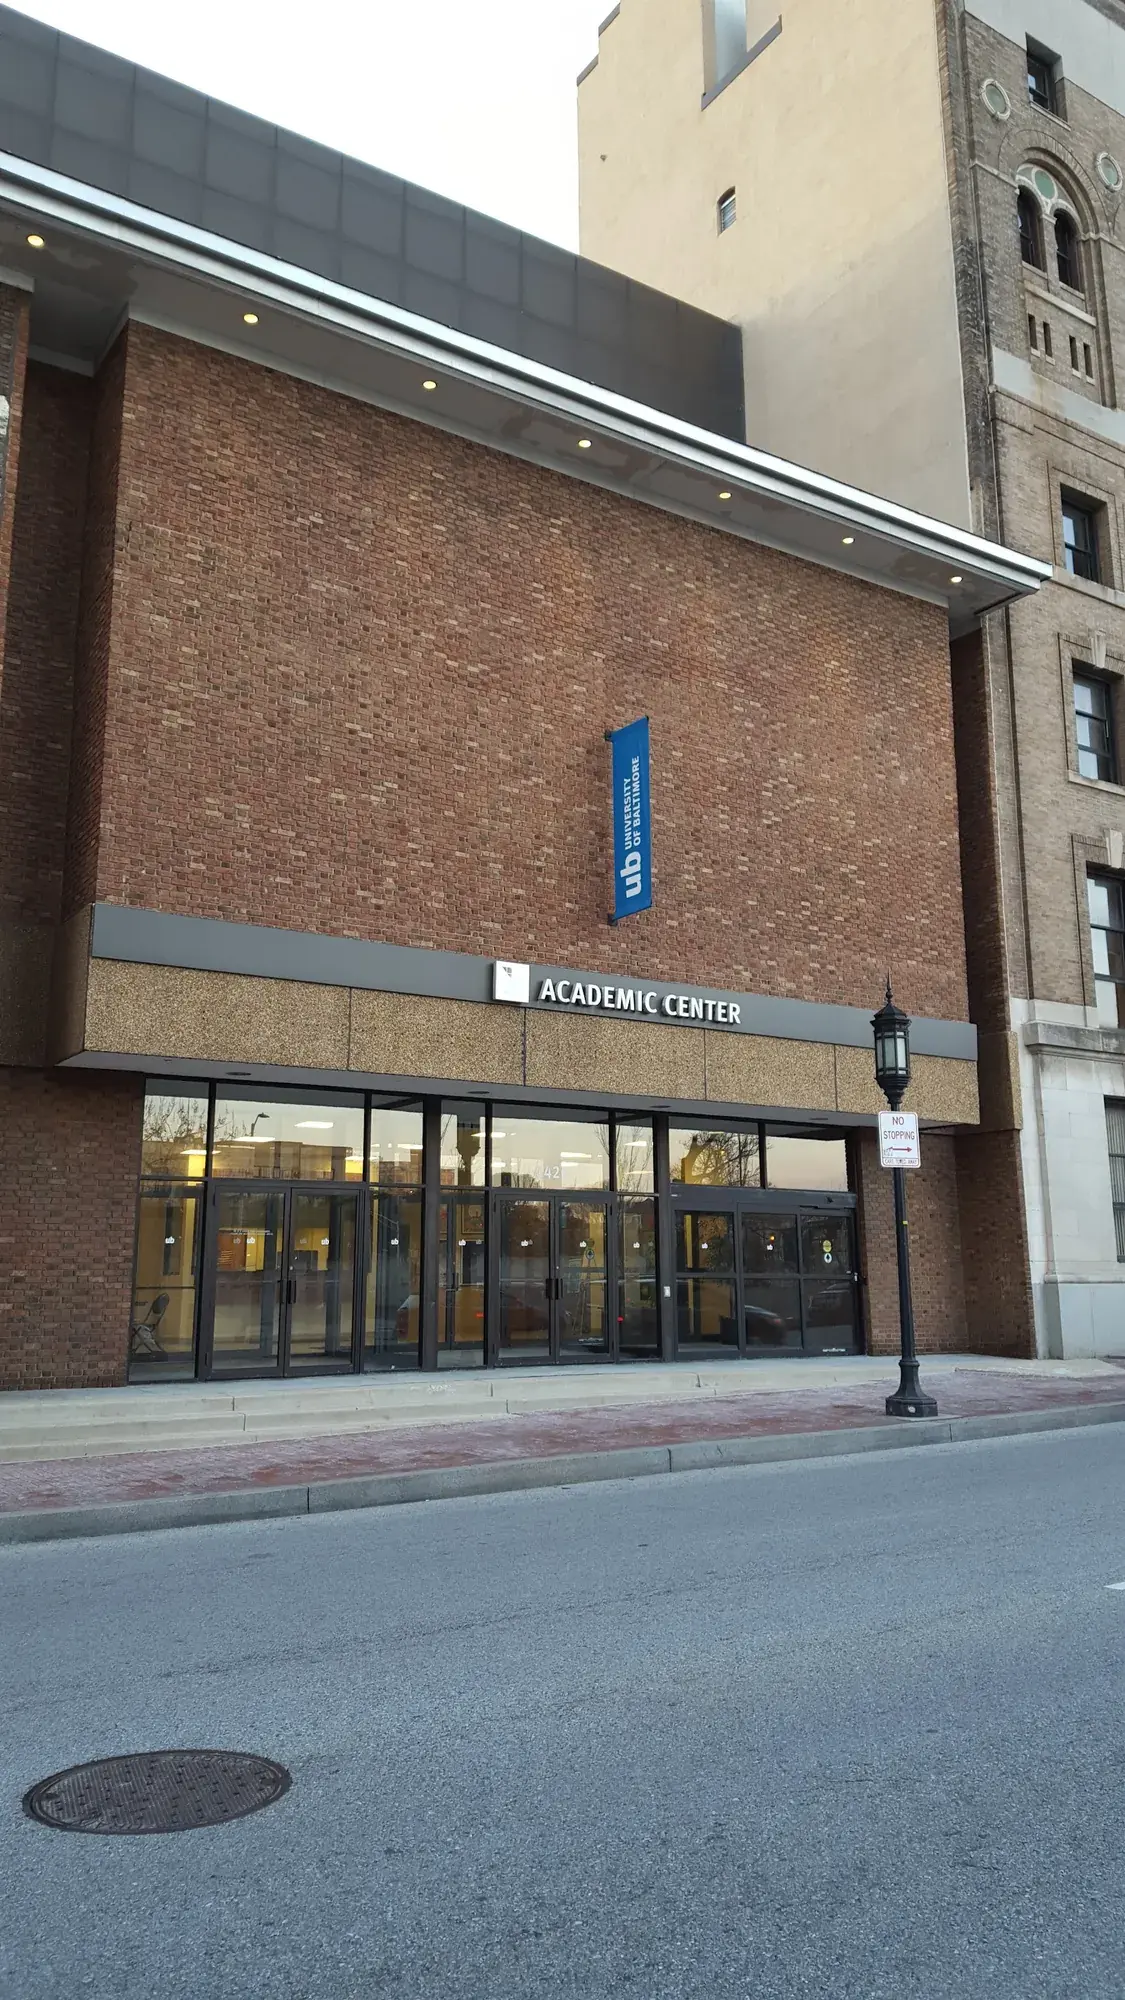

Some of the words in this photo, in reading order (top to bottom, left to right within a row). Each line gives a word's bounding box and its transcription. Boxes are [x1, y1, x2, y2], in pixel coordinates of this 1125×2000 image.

[623, 778, 632, 850] UNIVERSITY
[632, 755, 641, 827] BALTIMORE
[633, 829, 641, 847] OF
[620, 851, 642, 898] ub
[540, 978, 657, 1013] ACADEMIC
[662, 994, 741, 1024] CENTER
[883, 1130, 915, 1140] STOPPING
[892, 1116, 905, 1126] NO
